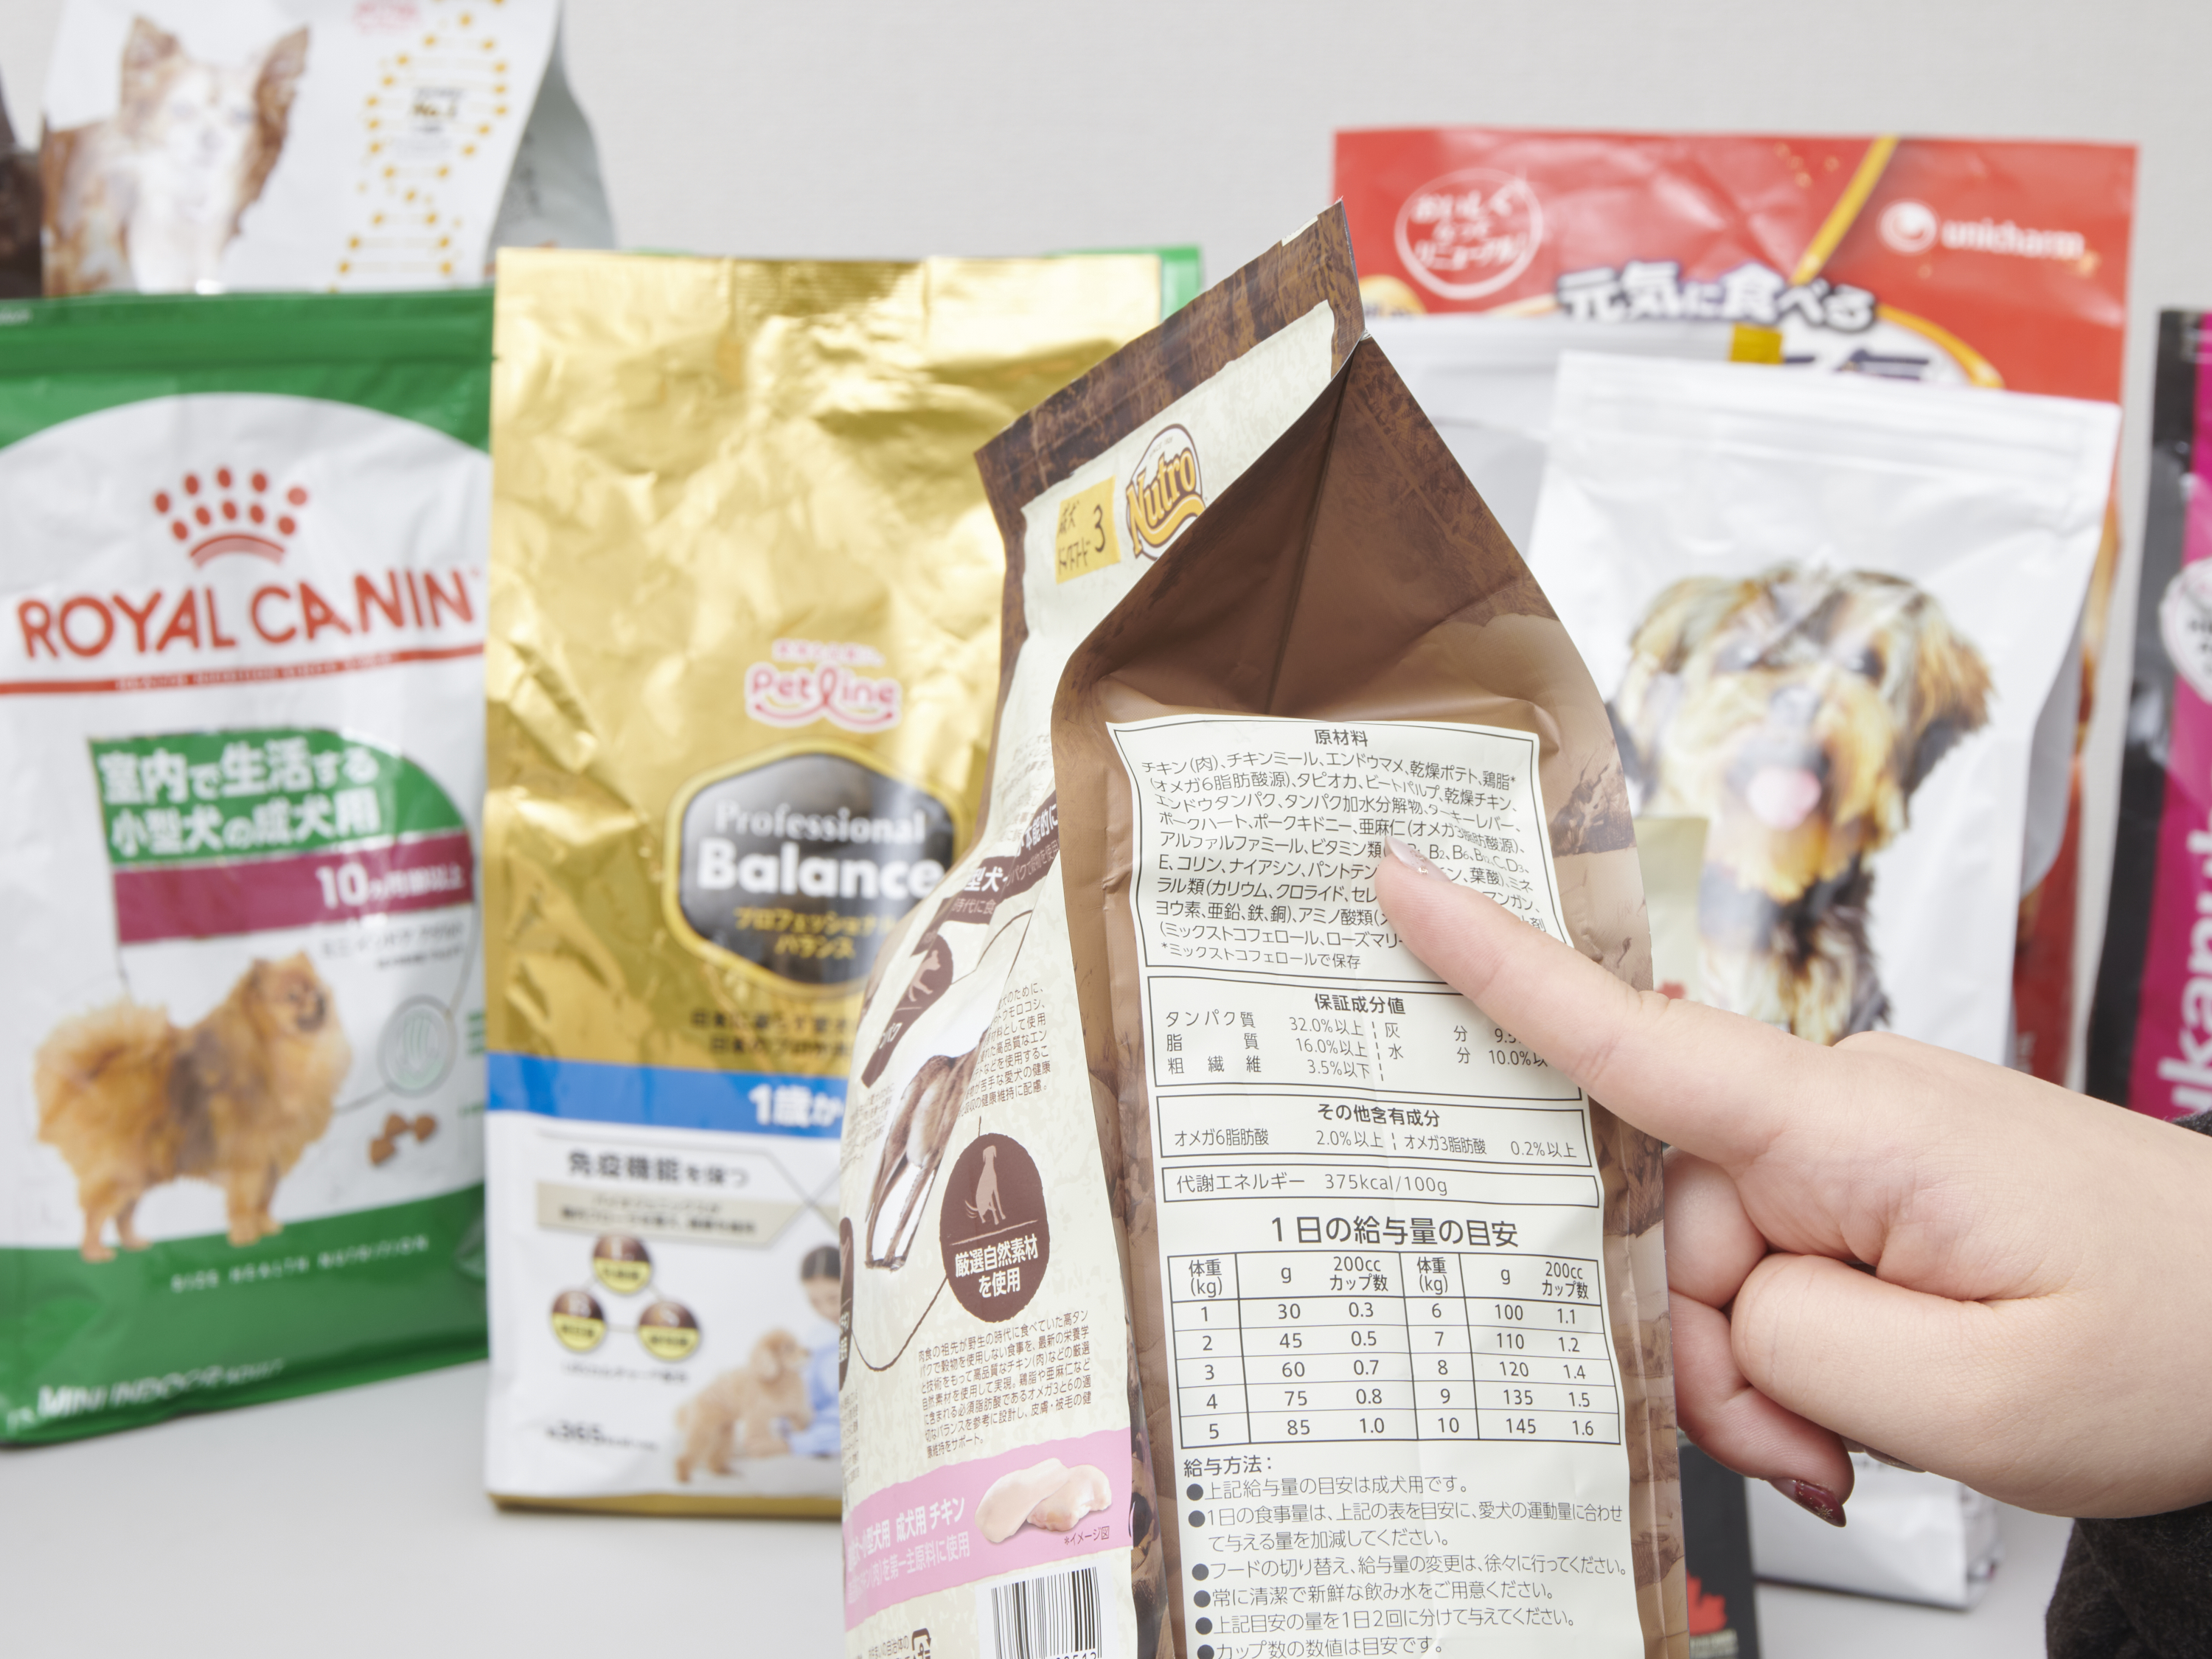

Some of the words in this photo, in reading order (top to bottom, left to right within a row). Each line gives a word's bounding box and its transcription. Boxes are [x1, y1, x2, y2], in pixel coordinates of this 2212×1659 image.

[1941, 218, 2085, 260] unicharm
[1557, 259, 1877, 333] 元気に食べる
[1125, 447, 1197, 559] Nutro
[16, 585, 237, 658] ROYAL
[248, 568, 476, 645] CANIN
[1315, 728, 1368, 747] 原材料
[99, 737, 380, 805] 室内で生活する
[111, 789, 382, 858] 小型犬の成犬用
[715, 799, 927, 845] Professional
[697, 836, 946, 900] Balance
[1160, 921, 1404, 948] (ミックストコフェロール、ローズマリ
[990, 999, 1045, 1029] やトウモロコシ、
[1314, 992, 1406, 1015] 保証成分値
[1166, 1009, 1256, 1029] タンパク質
[1289, 1016, 1364, 1037] 32.0%以上
[1295, 1037, 1368, 1058] 16.0%以上
[1307, 1057, 1370, 1080] 3.5%以下
[1318, 1102, 1440, 1128] その他含有成分
[1175, 1127, 1270, 1147] オメガ6脂肪酸
[1316, 1130, 1384, 1149] 2.0%以上
[1404, 1133, 1487, 1156] オメガ3脂肪酸
[1511, 1140, 1577, 1160] 0.2%以上
[1177, 1172, 1305, 1194] 代謝エネルギー
[1324, 1174, 1448, 1197] 375kcal/100g
[1271, 1216, 1520, 1248] 1日の給与量の目安
[955, 1234, 1038, 1277] 厳選自然素材
[979, 1267, 1020, 1298] を使用
[1188, 1259, 1222, 1278] 体重
[1280, 1265, 1293, 1284] g
[1332, 1255, 1382, 1273] 200cc
[1416, 1256, 1447, 1275] 体重
[1500, 1266, 1511, 1285] g
[1545, 1261, 1584, 1281] 200cc
[1189, 1276, 1223, 1298] (kg)
[1329, 1273, 1389, 1293] カップ数
[1418, 1273, 1449, 1295] (kg)
[1541, 1279, 1589, 1301] カップ数
[1200, 1306, 1208, 1322] 1
[1277, 1303, 1301, 1321] 30
[1348, 1301, 1374, 1318] 0.3
[1430, 1302, 1442, 1319] 6
[1493, 1304, 1524, 1321] 100
[1556, 1308, 1577, 1325] 1.1
[919, 1310, 1088, 1363] 肉食の祖先が野生の時代に食べていた高タン
[1202, 1335, 1213, 1352] 2
[1279, 1332, 1303, 1349] 45
[1350, 1330, 1377, 1347] 0.5
[1433, 1331, 1444, 1347] 7
[1495, 1332, 1526, 1350] 110
[1557, 1336, 1581, 1353] 1.2
[1203, 1363, 1215, 1380] 3
[1281, 1361, 1306, 1378] 60
[1352, 1359, 1380, 1376] 0.7
[1436, 1359, 1449, 1377] 8
[1498, 1360, 1530, 1378] 120
[1562, 1363, 1587, 1380] 1.4
[1205, 1393, 1219, 1410] 4
[1284, 1390, 1307, 1407] 75
[1355, 1388, 1382, 1405] 0.8
[1439, 1388, 1451, 1405] 9
[1502, 1388, 1534, 1406] 135
[1568, 1391, 1591, 1408] 1.5
[1208, 1423, 1220, 1440] 5
[1286, 1419, 1311, 1436] 85
[1359, 1417, 1385, 1435] 1.0
[1437, 1416, 1460, 1434] 10
[1505, 1417, 1537, 1435] 145
[1571, 1419, 1595, 1436] 1.6
[1205, 1475, 1468, 1500] 上記給与量の目安は成犬用です。
[897, 1506, 927, 1543] 成犬用
[930, 1497, 964, 1530] チキン
[1207, 1501, 1623, 1527] 1日の食事量は、上記の表を目安に、愛犬の運動量に合わせ
[1208, 1529, 1450, 1553] て与える量を加減してください。
[1210, 1554, 1627, 1580] フードの切り替え、給与量の変更は、徐々に行ってください。
[1212, 1580, 1554, 1607] 常に清潔で新鮮な飲み水をご用意ください。
[1214, 1608, 1575, 1635] 上記目安の量を1日2回に分けて与えてください。
[1216, 1636, 1443, 1659] カップ数の数値は目安です。
